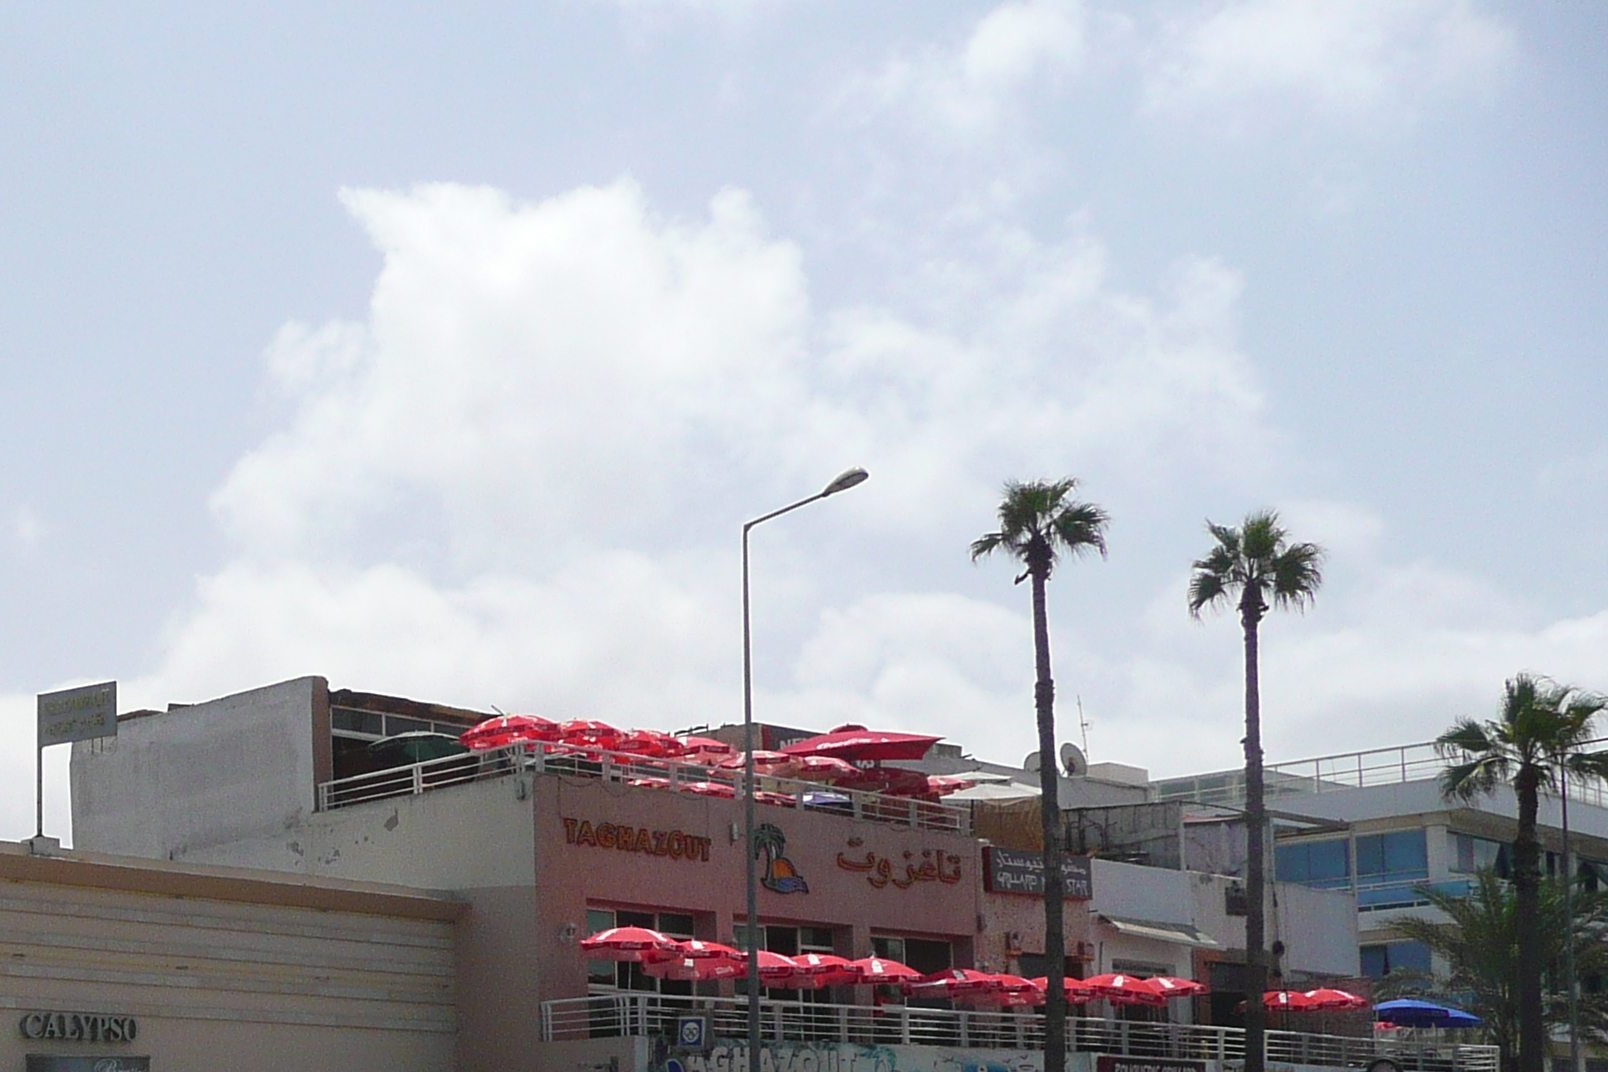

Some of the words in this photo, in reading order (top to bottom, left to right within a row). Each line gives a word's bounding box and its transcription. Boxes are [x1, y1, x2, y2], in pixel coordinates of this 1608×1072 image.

[563, 818, 712, 862] TAGHAZOUT
[836, 836, 962, 890] تاغزوت
[1066, 879, 1089, 896] STAR
[25, 1012, 140, 1042] CALYPSO
